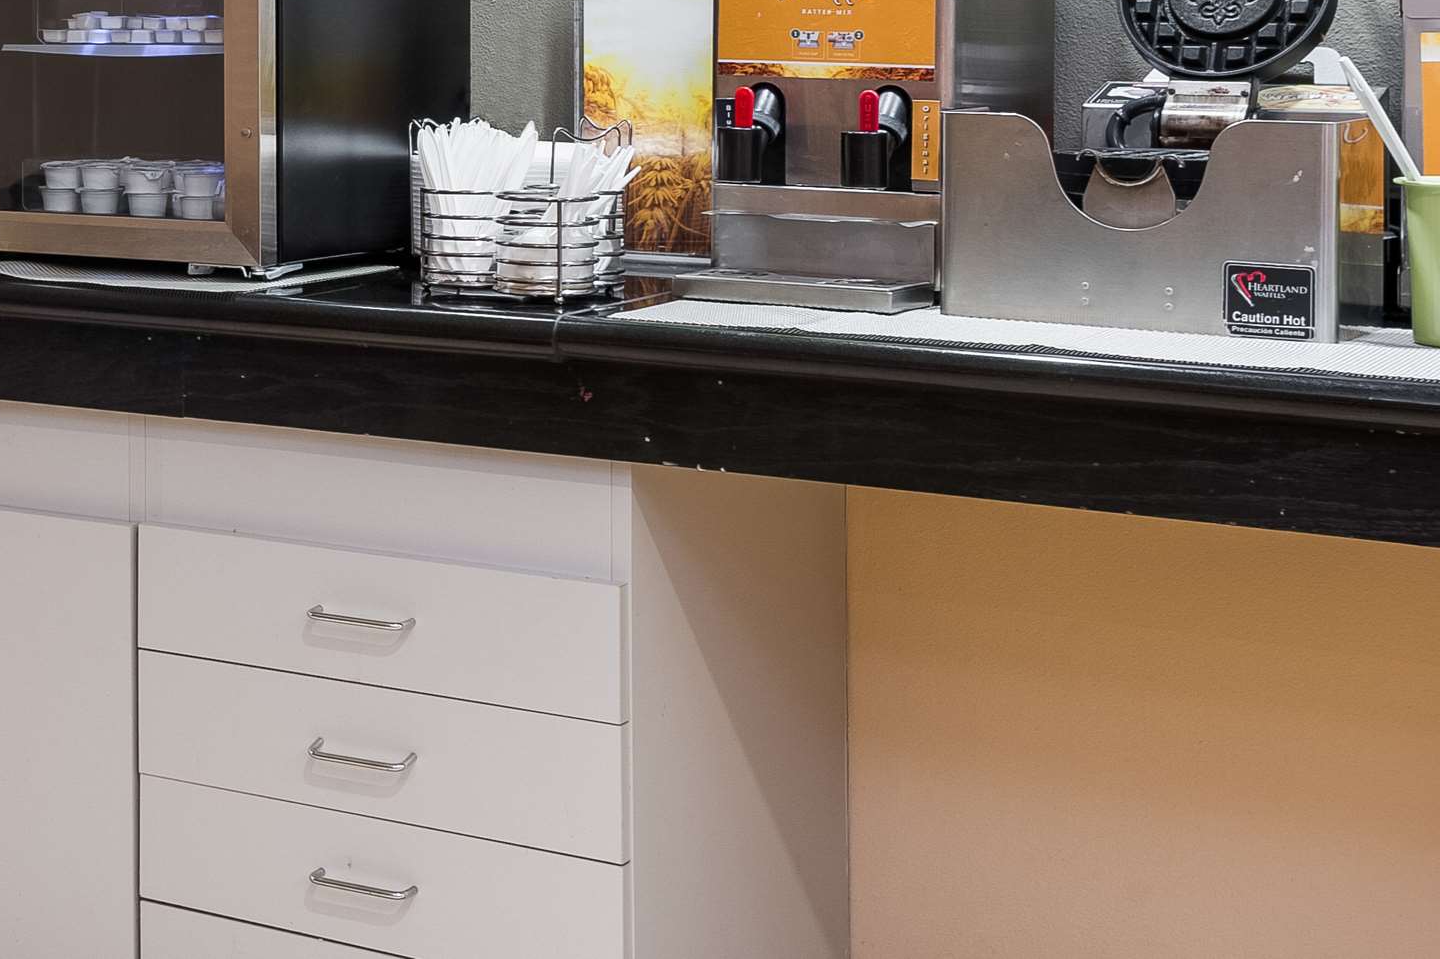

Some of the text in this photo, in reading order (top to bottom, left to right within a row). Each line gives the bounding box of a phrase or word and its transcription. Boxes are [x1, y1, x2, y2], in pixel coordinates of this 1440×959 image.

[921, 105, 931, 174] Original
[1247, 281, 1308, 295] HEARTLAND
[1253, 291, 1286, 299] WAFFLES
[1231, 310, 1307, 326] Caution Hot
[1231, 325, 1306, 337] Precaución Caliente
